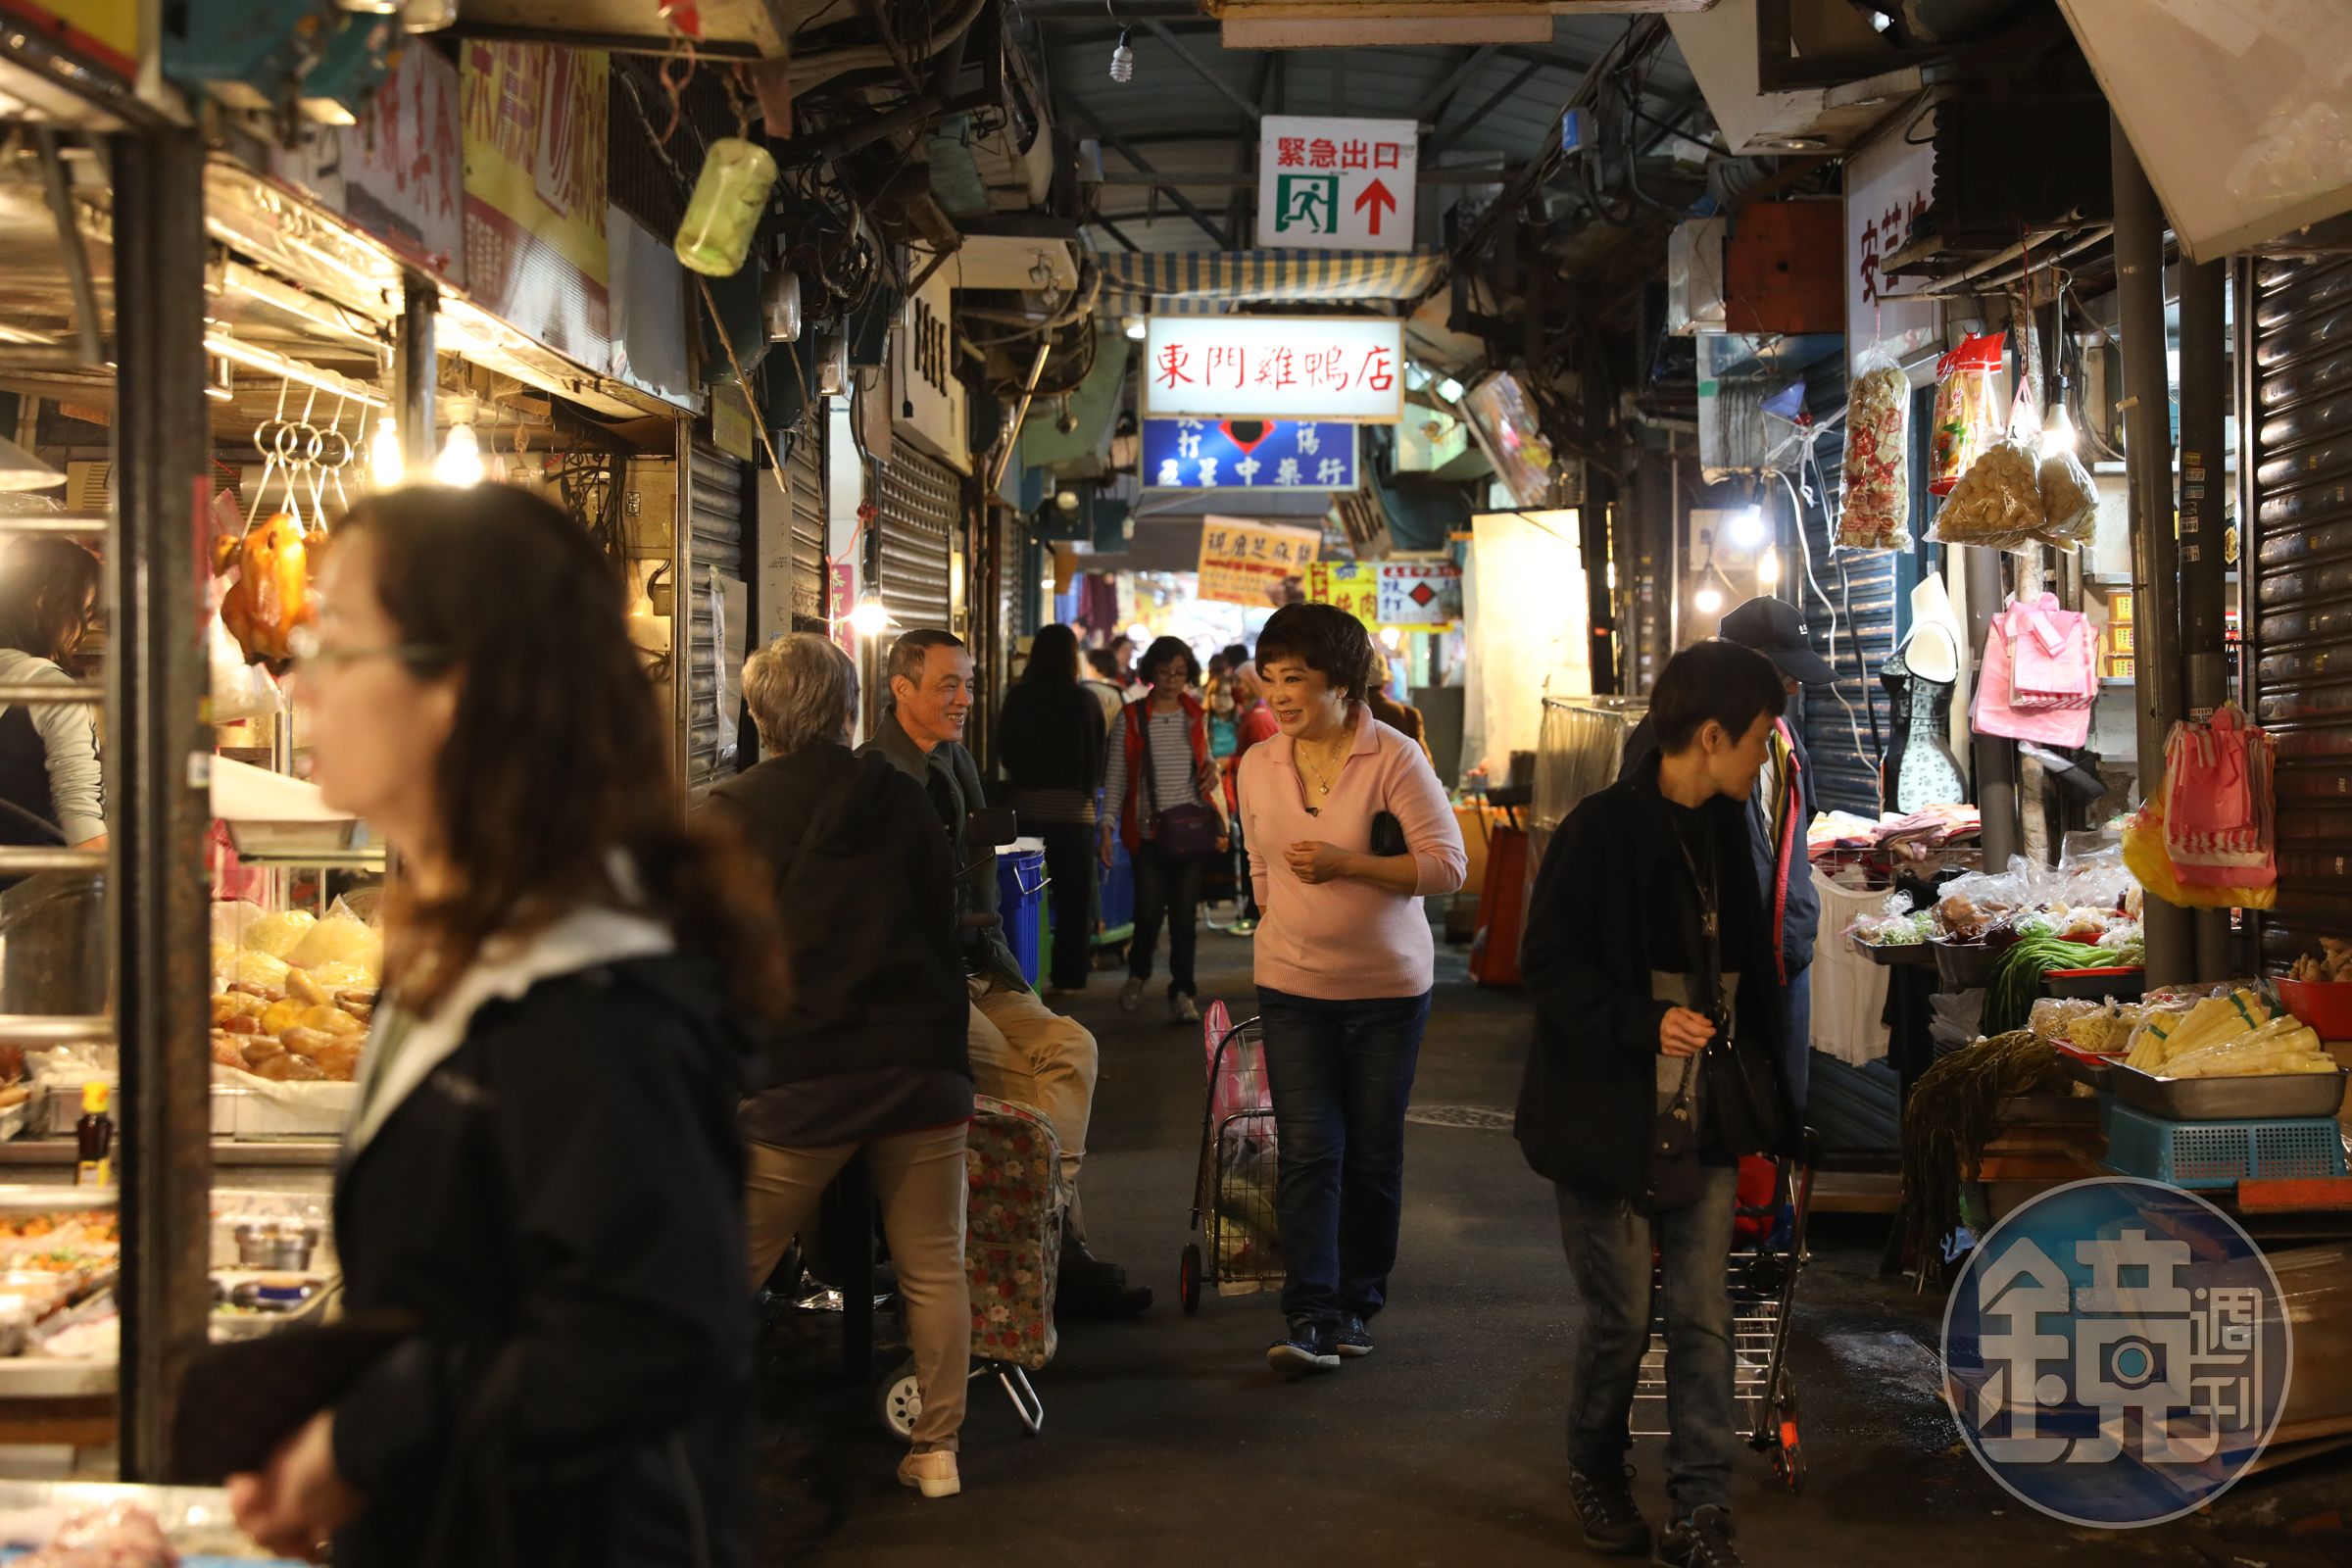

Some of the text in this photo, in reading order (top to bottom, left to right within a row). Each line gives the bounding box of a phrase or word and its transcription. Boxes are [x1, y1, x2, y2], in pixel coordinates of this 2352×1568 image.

[1278, 137, 1399, 170] 緊急出口
[1155, 343, 1395, 391] 東門雞鴨店
